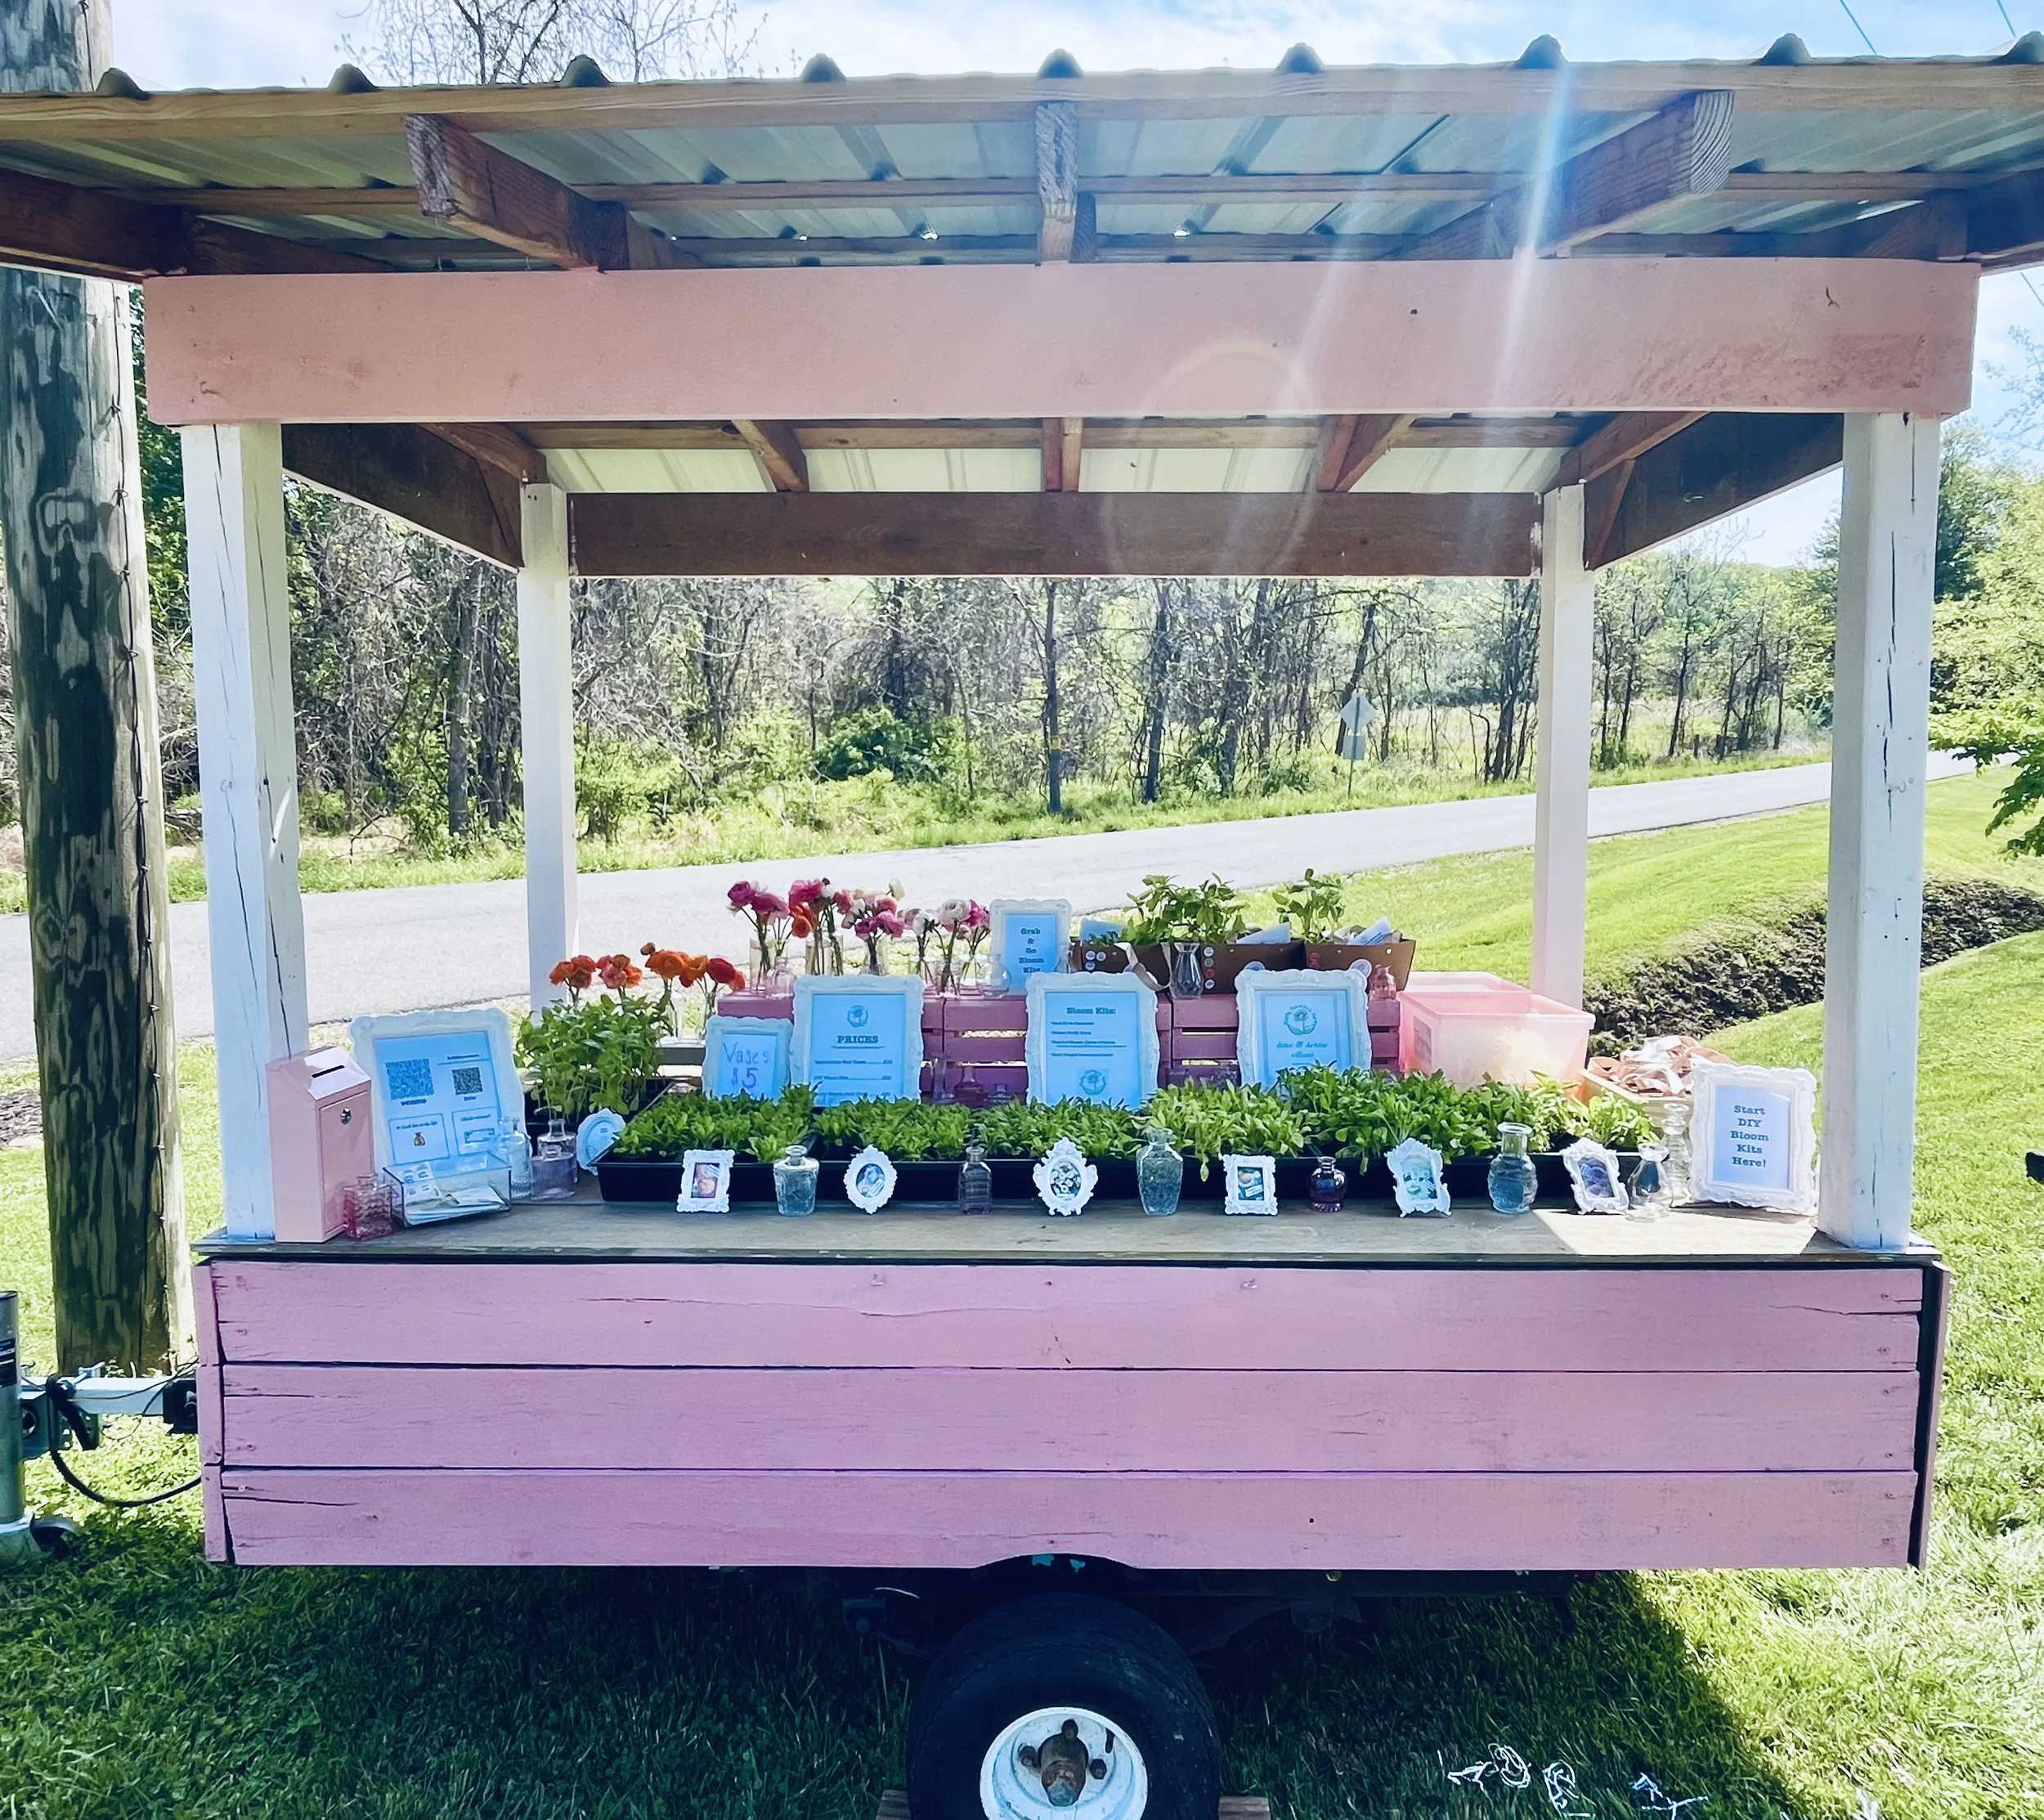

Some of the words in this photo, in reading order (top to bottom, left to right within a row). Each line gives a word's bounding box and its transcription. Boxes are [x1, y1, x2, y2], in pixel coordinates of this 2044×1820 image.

[836, 1035, 879, 1044] PRICES
[722, 1041, 769, 1065] Vases
[1733, 1105, 1766, 1115] Start
[1737, 1118, 1763, 1127] DIY
[1729, 1130, 1769, 1141] Bloom
[1736, 1144, 1763, 1154] Kits
[1732, 1156, 1767, 1168] Here!
